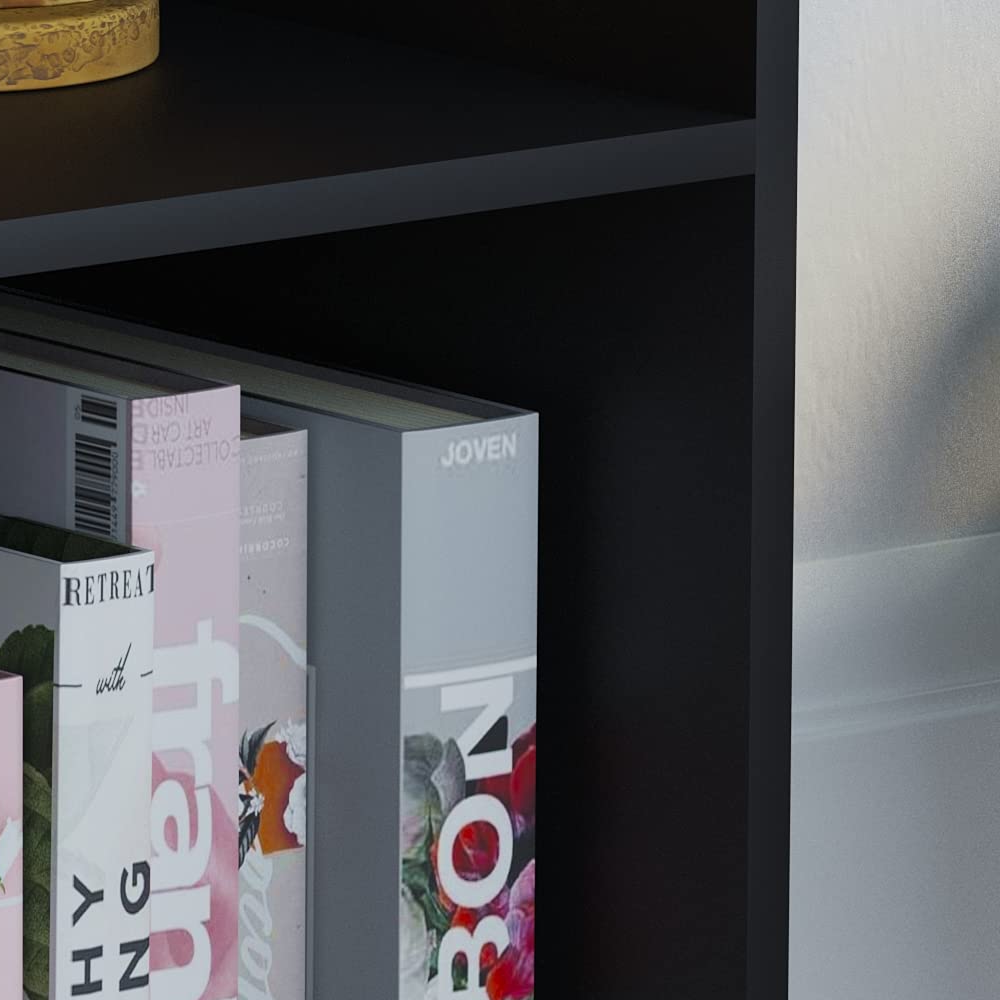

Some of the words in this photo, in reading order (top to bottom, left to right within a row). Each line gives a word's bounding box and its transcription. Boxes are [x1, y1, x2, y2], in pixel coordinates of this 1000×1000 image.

[441, 433, 516, 466] JOVEN
[62, 563, 154, 606] RETREAT
[96, 642, 132, 695] with
